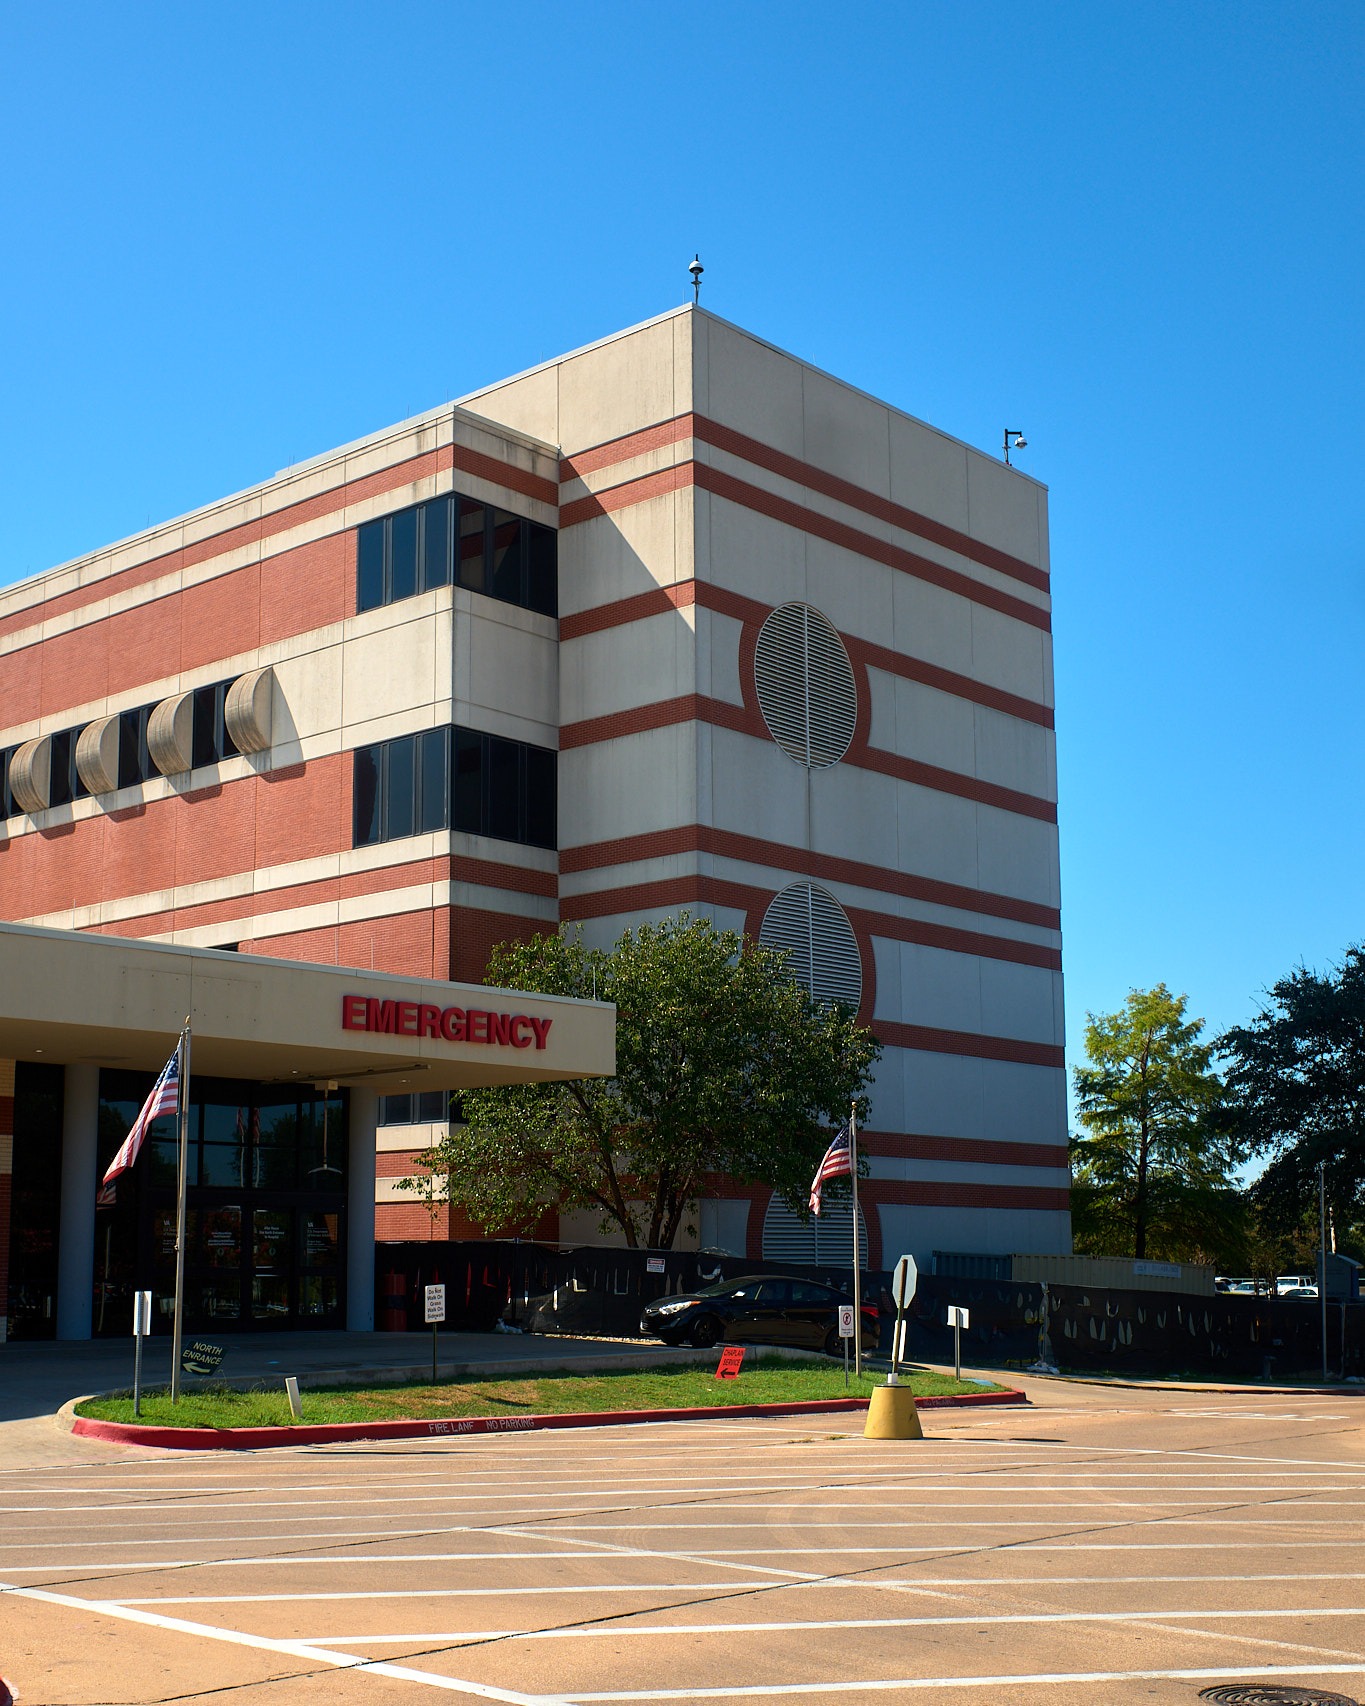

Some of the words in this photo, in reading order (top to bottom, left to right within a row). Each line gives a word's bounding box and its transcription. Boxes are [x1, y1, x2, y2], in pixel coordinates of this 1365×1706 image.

[342, 995, 553, 1049] EMERGENCY
[192, 1341, 223, 1356] NORTH
[182, 1349, 222, 1365] ENRANCE
[428, 1422, 449, 1434] FIRE
[486, 1420, 499, 1431] NO
[500, 1417, 535, 1430] PARKING
